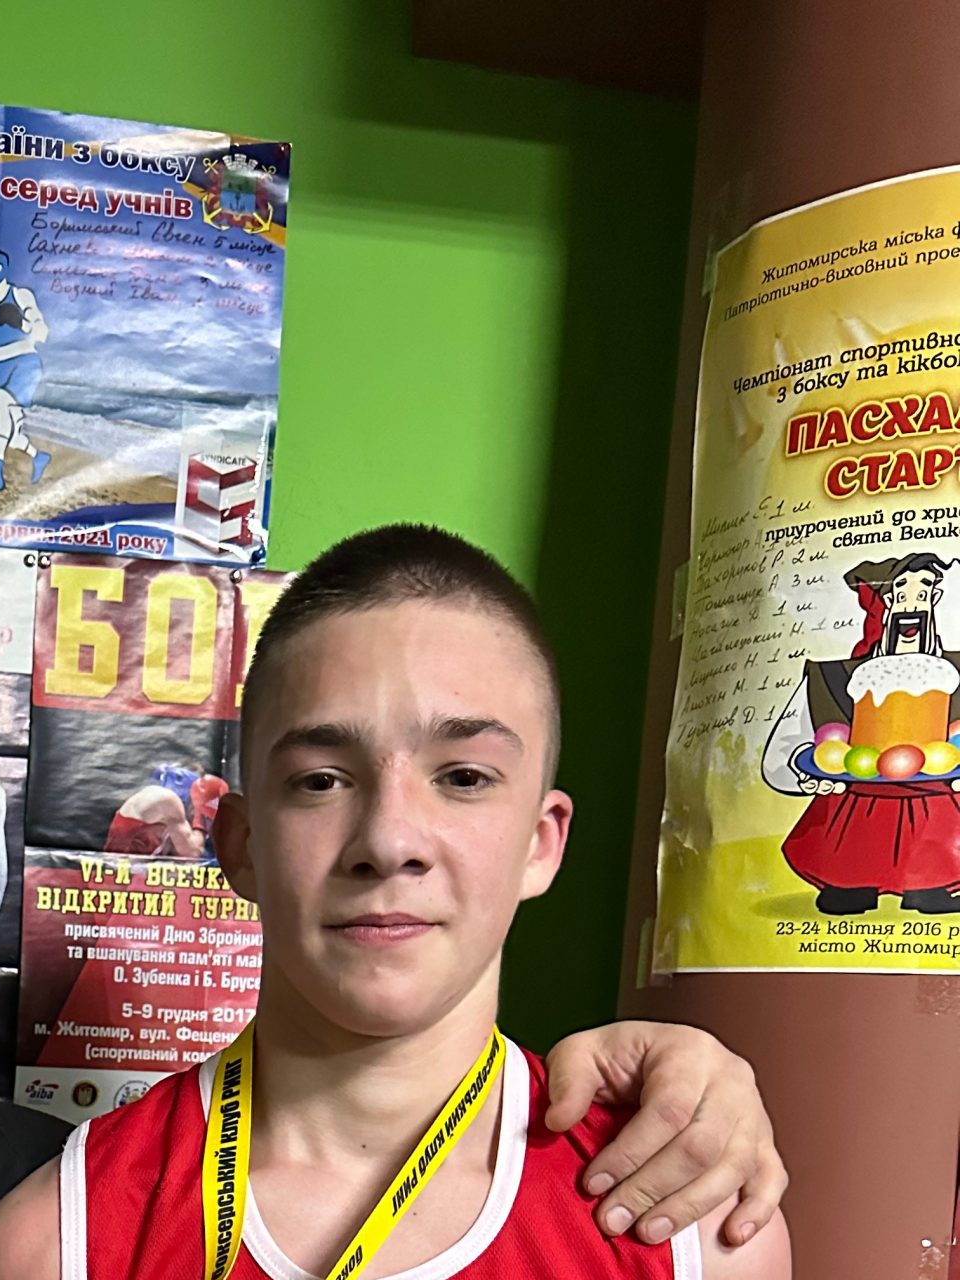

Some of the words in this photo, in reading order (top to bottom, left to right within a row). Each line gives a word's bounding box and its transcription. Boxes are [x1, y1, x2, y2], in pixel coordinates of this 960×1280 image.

[98, 142, 197, 182] боксу
[0, 174, 100, 212] серед
[104, 184, 194, 221] учнів
[760, 237, 878, 285] Житомирська
[884, 222, 945, 250] міська
[732, 353, 833, 396] Чемпіонат
[793, 367, 850, 396] боксу
[856, 362, 889, 382] та
[785, 390, 960, 457] ПАСХА
[764, 511, 885, 543] приурочений
[891, 507, 916, 527] до
[831, 530, 892, 548] свята
[116, 532, 168, 556] року
[36, 886, 177, 918] ВІДКРИТИЙ
[191, 895, 261, 922] ТУРНІ
[64, 923, 160, 947] присвячений
[163, 925, 195, 945] Дню
[775, 921, 820, 936] 23-24
[826, 921, 896, 936] квітня
[901, 921, 942, 937] 2016
[798, 938, 856, 954] місто
[67, 945, 83, 960] та
[87, 948, 175, 965] вшанування
[179, 950, 233, 967] пам'яті
[132, 968, 191, 988] Зубенка
[203, 973, 217, 989] Б.
[34, 1023, 51, 1036] м.
[56, 1021, 134, 1042] Житомир,
[140, 1027, 171, 1042] вул.
[157, 1008, 209, 1025] грудня
[212, 1006, 258, 1024] 2017
[85, 1043, 179, 1064] (спортивний
[221, 1057, 243, 1102] РИНГ
[219, 1099, 241, 1144] клуб
[392, 1166, 419, 1217] РИНГ
